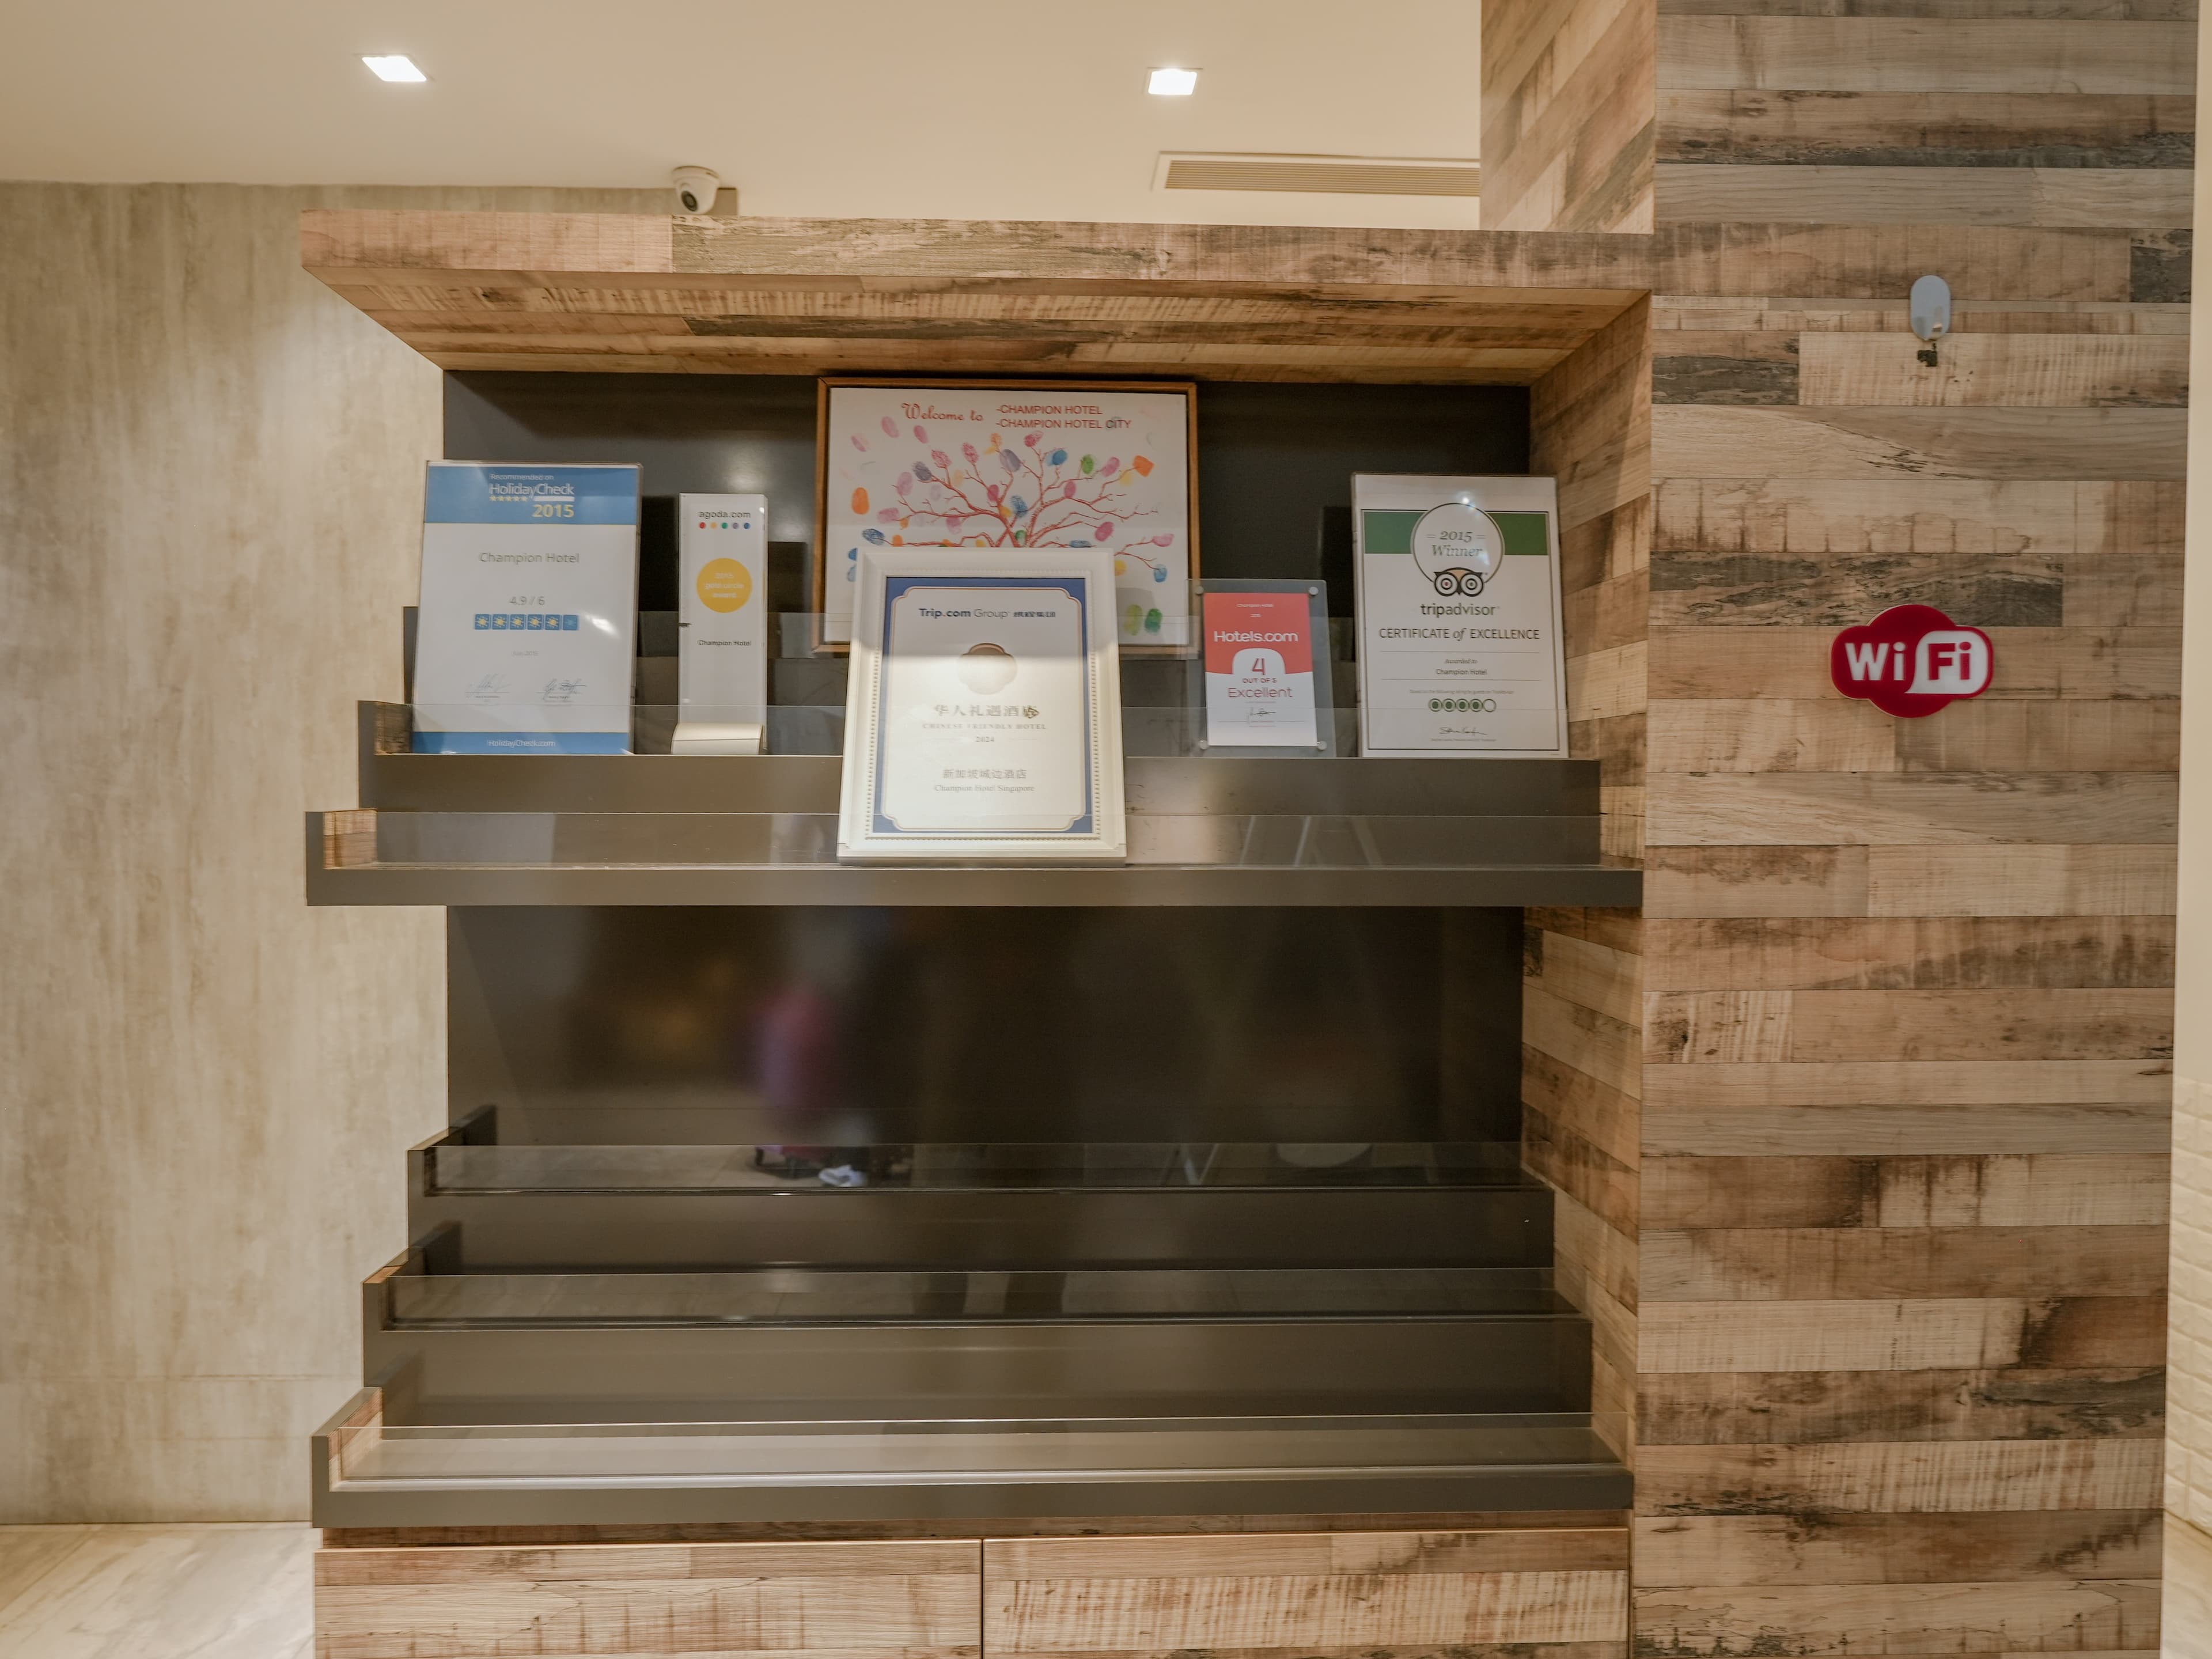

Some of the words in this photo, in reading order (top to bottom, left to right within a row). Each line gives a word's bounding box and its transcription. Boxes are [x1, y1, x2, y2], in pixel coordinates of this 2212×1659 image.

[901, 403, 965, 421] Welcome
[970, 409, 984, 421] to
[996, 404, 1062, 414] -CHAMPION
[1065, 405, 1103, 415] HOTEL
[996, 419, 1062, 428] -CHAMPION
[1065, 419, 1102, 429] HOTEL
[1105, 419, 1131, 429] CITY
[489, 483, 575, 498] HolidayCheck
[532, 504, 574, 517] 2015
[698, 511, 751, 519] agoda.com
[1440, 531, 1473, 543] 2015
[1431, 545, 1483, 556] Winner
[479, 552, 543, 565] Champion
[546, 552, 579, 563] Hotel
[509, 596, 527, 605] 4.9
[538, 596, 546, 605] 6
[918, 608, 971, 619] Trip.com
[974, 608, 1009, 619] Group
[1421, 604, 1497, 618] tripadvisor
[1213, 631, 1299, 642] Hotels.com
[1378, 628, 1450, 639] CERTIFICATE
[1453, 628, 1467, 641] of
[1470, 629, 1540, 639] EXCELLENCE
[1252, 658, 1266, 676] 4
[1227, 687, 1293, 698] Excellent
[487, 739, 556, 748] HolidayCheck.com
[934, 784, 973, 793] Champion
[974, 784, 996, 792] Hotel
[998, 784, 1035, 793] Singapore
